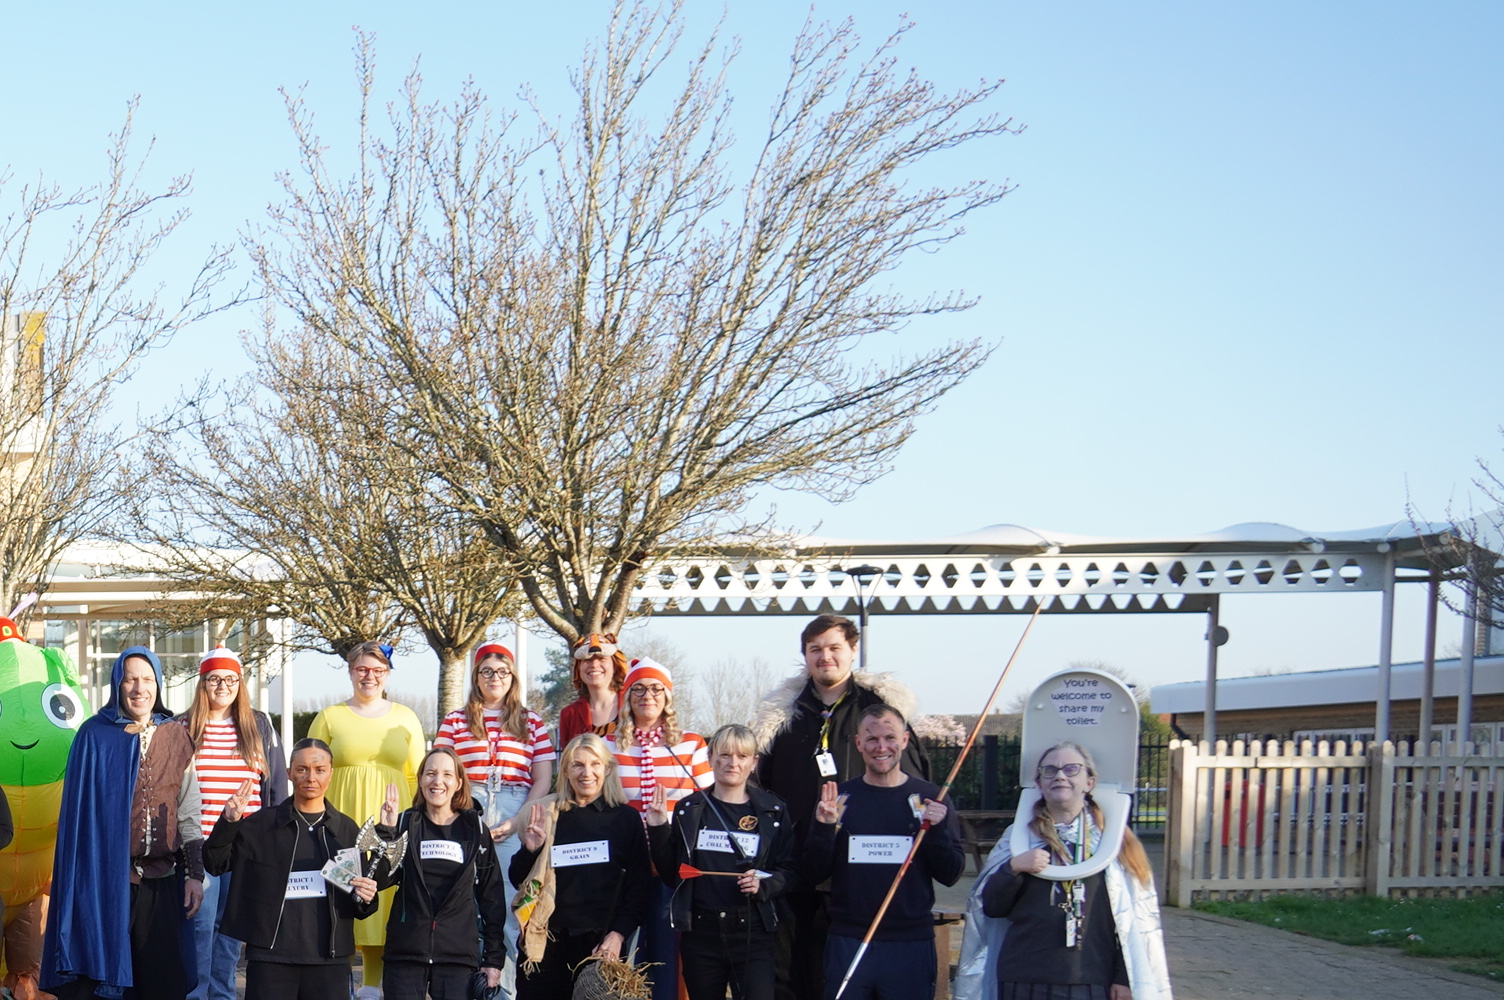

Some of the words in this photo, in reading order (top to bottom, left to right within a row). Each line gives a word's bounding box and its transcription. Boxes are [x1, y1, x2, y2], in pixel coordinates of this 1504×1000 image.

[1063, 679, 1098, 688] You're
[1050, 692, 1097, 700] welcome
[1099, 692, 1112, 700] to
[1058, 705, 1088, 713] share
[1090, 705, 1105, 713] my
[562, 847, 592, 855] DISTRICT
